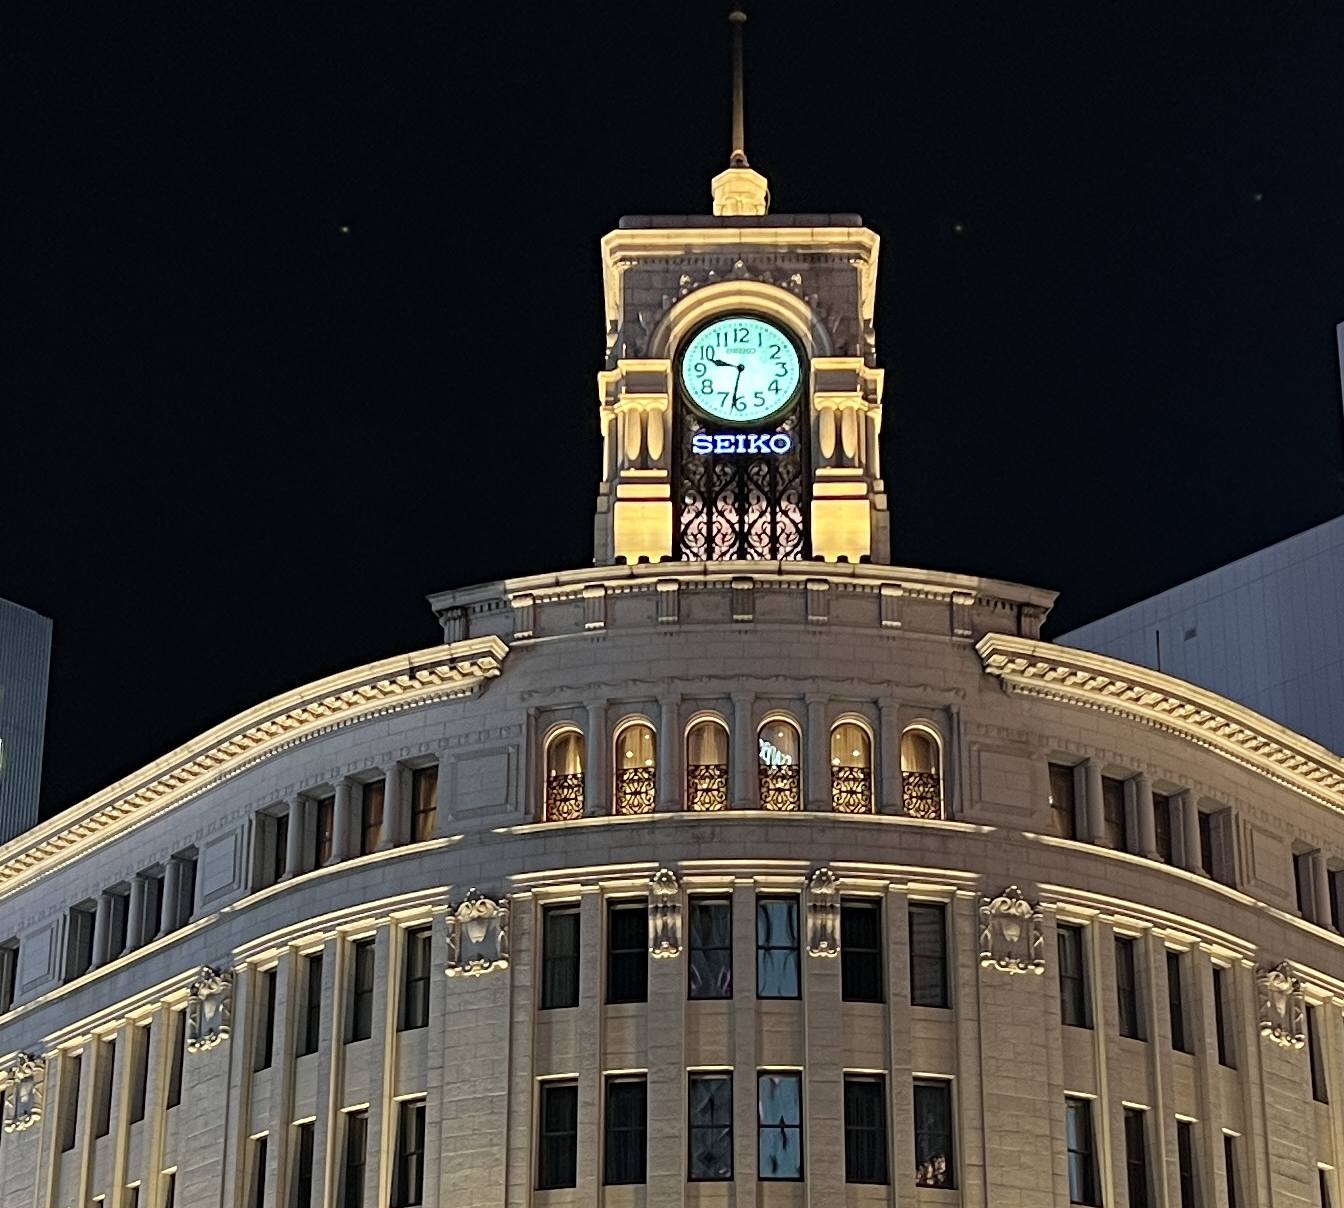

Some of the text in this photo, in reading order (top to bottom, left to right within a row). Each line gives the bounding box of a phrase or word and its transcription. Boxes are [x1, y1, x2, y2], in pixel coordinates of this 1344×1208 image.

[716, 332, 728, 347] 11
[733, 328, 750, 344] 12
[700, 345, 715, 361] 10
[769, 344, 781, 360] 2
[694, 362, 707, 378] 9
[775, 362, 788, 377] 3
[701, 379, 714, 395] 8
[767, 379, 782, 395] 4
[717, 391, 730, 408] 7
[734, 395, 747, 412] 6
[753, 391, 766, 407] 5
[692, 433, 792, 455] SEIKO
